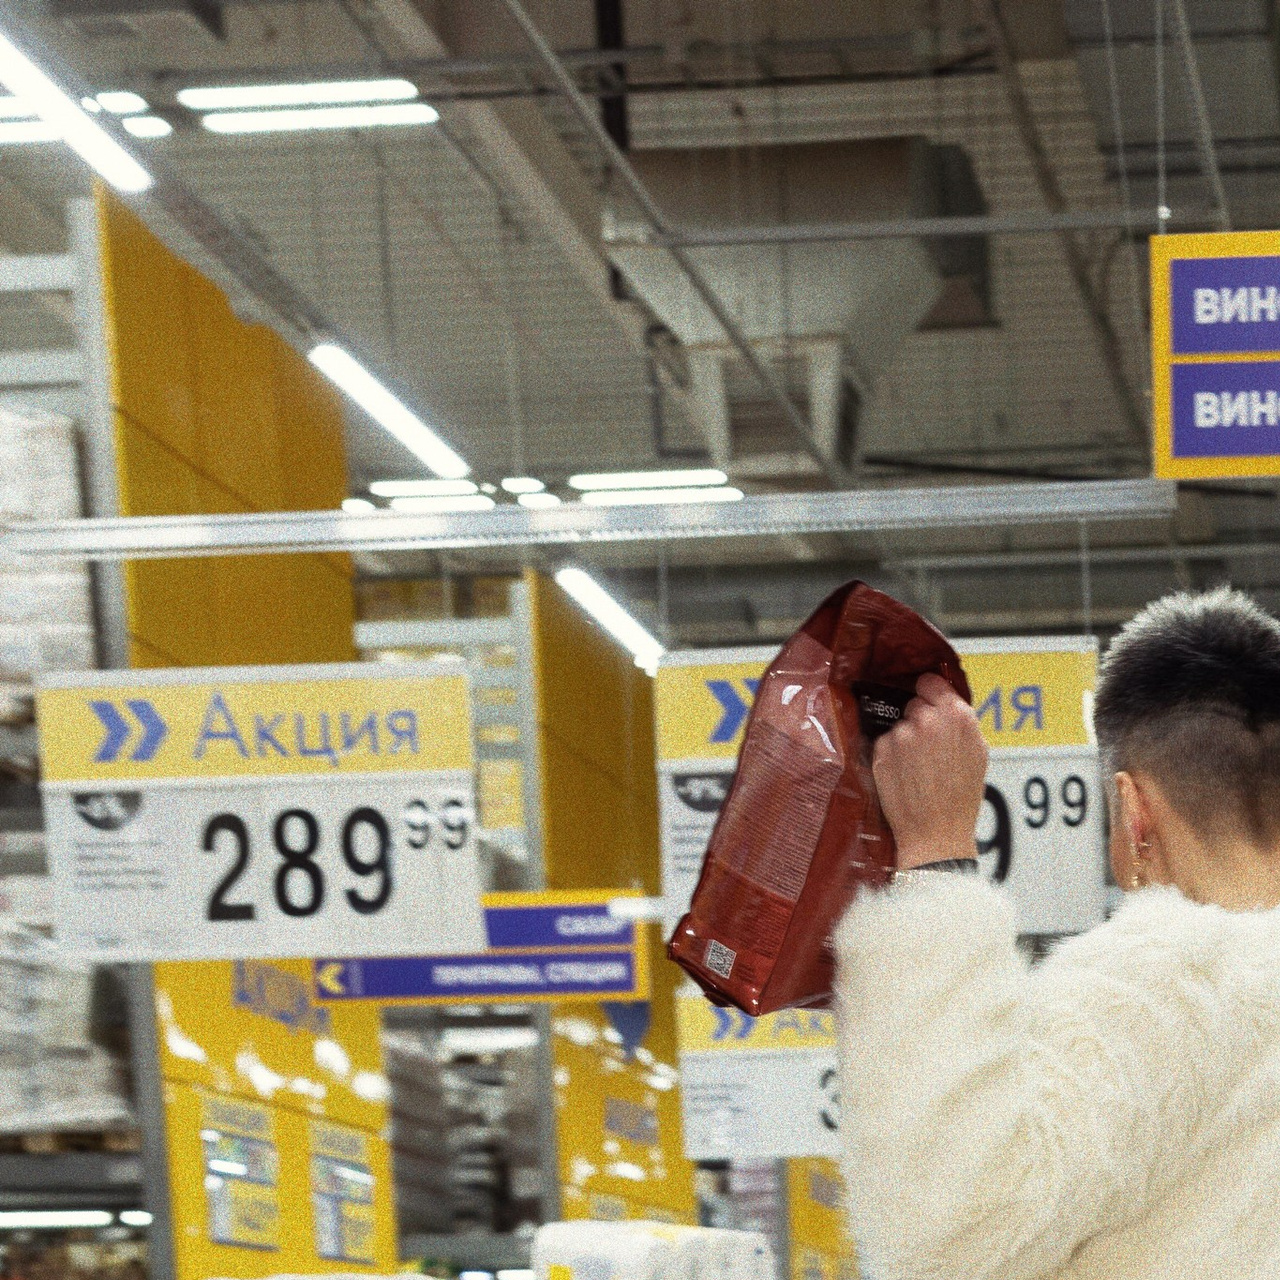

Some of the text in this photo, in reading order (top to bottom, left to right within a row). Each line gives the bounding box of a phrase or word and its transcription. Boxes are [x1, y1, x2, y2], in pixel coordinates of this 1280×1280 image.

[192, 693, 421, 767] Акция
[1023, 775, 1087, 829] 99
[201, 807, 394, 922] 289
[404, 799, 469, 850] 99
